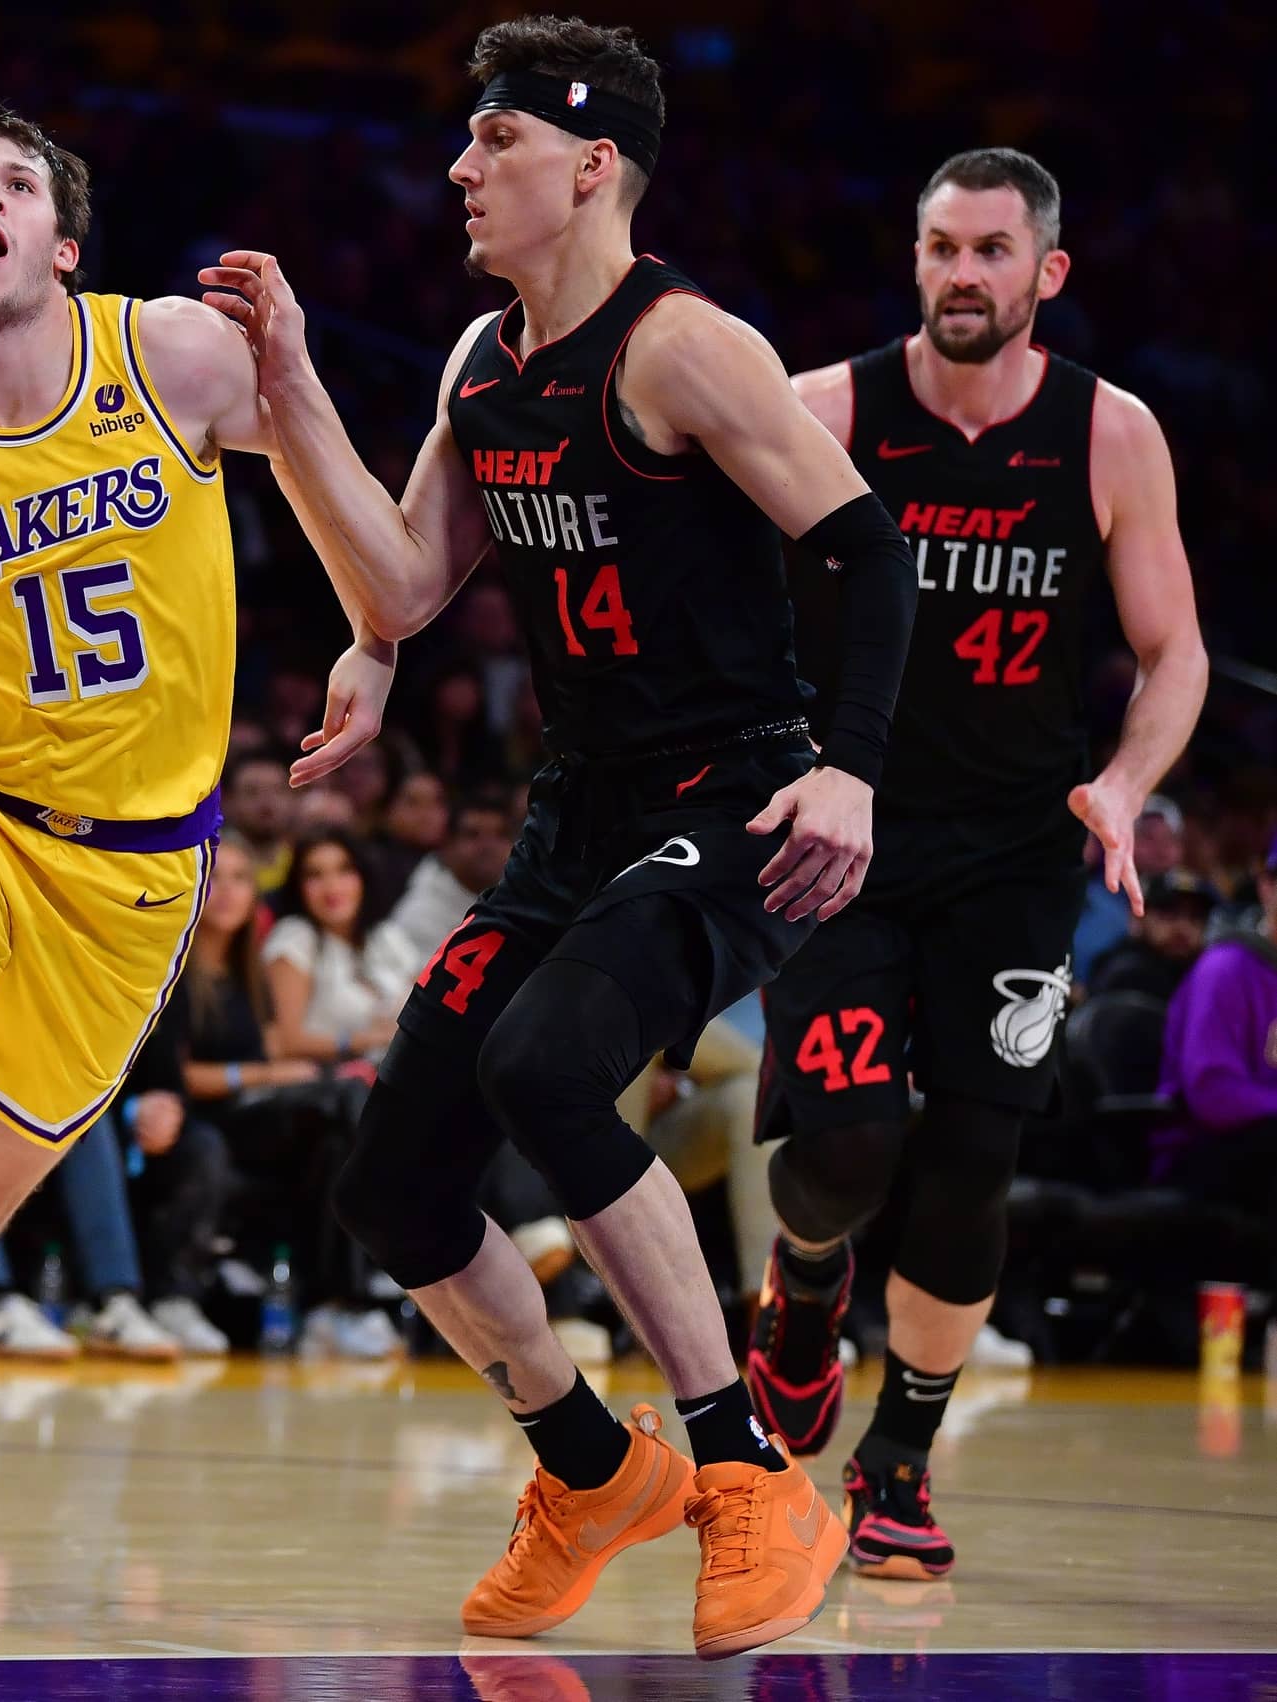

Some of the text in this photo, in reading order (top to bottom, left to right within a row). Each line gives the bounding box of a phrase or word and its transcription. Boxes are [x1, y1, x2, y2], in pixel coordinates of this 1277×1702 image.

[89, 412, 145, 437] bibigo
[474, 437, 570, 486] HEAT
[481, 488, 619, 552] ULTURE
[899, 499, 1037, 541] HEAT
[904, 536, 1067, 598] LTURE
[10, 558, 151, 706] 15
[554, 564, 639, 657] 14
[952, 607, 1050, 687] 42
[417, 913, 506, 1016] 14
[795, 1006, 892, 1093] 42
